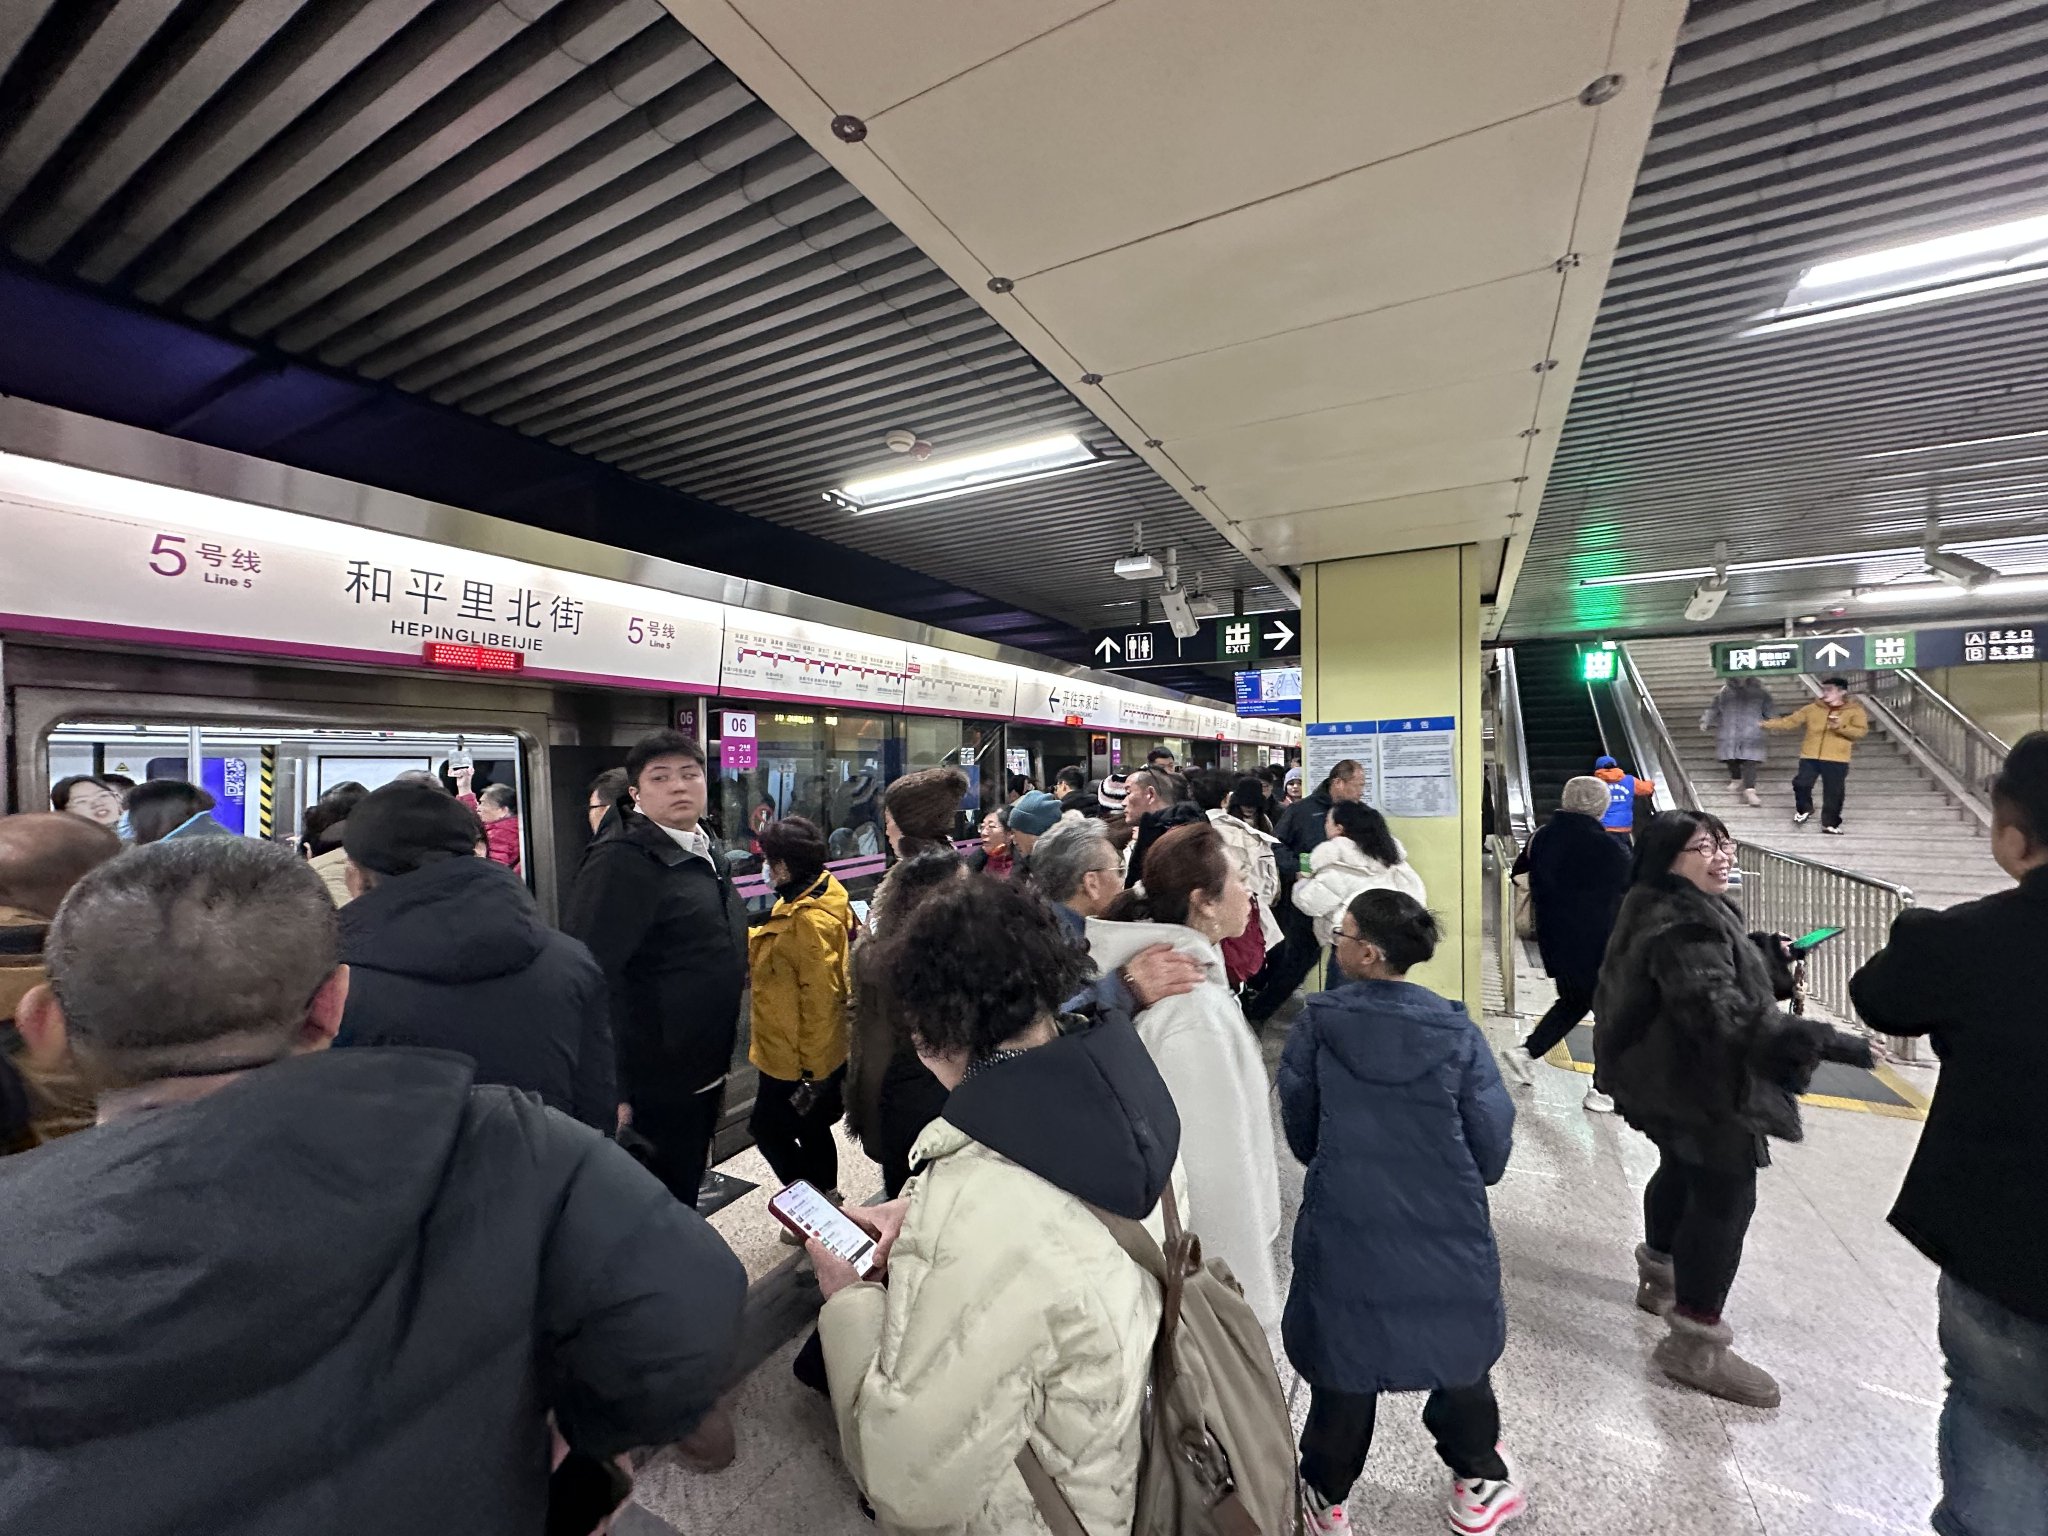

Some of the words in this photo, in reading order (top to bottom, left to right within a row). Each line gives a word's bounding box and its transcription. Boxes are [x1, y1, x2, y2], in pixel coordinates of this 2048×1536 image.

[149, 533, 262, 577] 5号线
[204, 572, 238, 588] Line
[243, 578, 252, 589] 5
[344, 559, 584, 636] 和平里北街
[391, 619, 543, 652] HEPINGLIBEIJIE
[628, 616, 675, 645] 5号线
[650, 640, 665, 649] Line
[666, 642, 671, 650] 5
[1225, 644, 1251, 654] EXIT
[1762, 659, 1788, 667] EXIT
[1875, 657, 1904, 666] EXIT
[1062, 690, 1100, 711] 开往宋家庄
[680, 711, 693, 725] 06
[731, 718, 747, 732] 06
